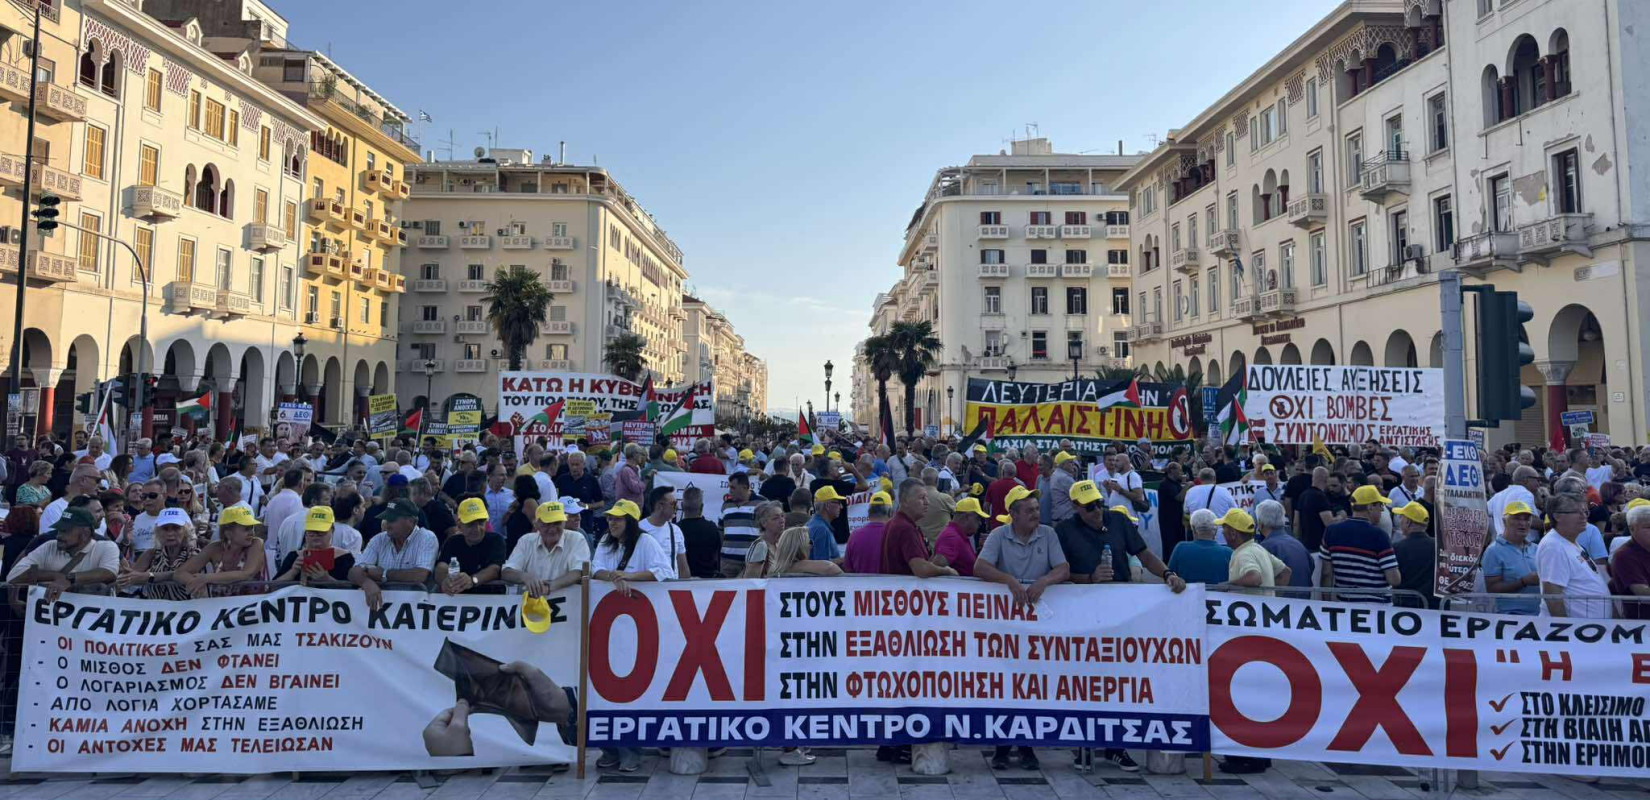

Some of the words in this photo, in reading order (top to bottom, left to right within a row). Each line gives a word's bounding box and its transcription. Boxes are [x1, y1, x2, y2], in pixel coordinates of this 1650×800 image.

[502, 377, 563, 392] ΚΑΤΩ
[568, 378, 584, 393] Η
[1249, 366, 1331, 391] ΔΟΥΛΕΙΕΣ
[1341, 368, 1423, 393] ΑΥΞΗΣΕΙΣ
[503, 396, 531, 406] ΤΟΥ
[611, 398, 638, 410] ΤΗΣ
[981, 381, 1098, 404] ΛΕΥΤΕΡΙΑ
[1327, 396, 1393, 421] ΒΟΜΒΕΣ
[978, 404, 1164, 440] ΠΑΛΑΙΣΤΙΝΗ
[1273, 422, 1376, 444] ΣΥΝΤΟΝΙΣΜΟΣ
[1379, 425, 1432, 436] ΕΡΓΑΤΙΚΗΣ
[1444, 463, 1479, 487] ΔΕΘ
[34, 598, 202, 636] ΕΡΓΑΤΙΚΟ
[211, 596, 352, 631] ΚΕΝΤΡΟ
[367, 596, 568, 632] ΚΑΤΕΡΙΝΣ
[780, 591, 846, 618] ΣΤΟΥΣ
[854, 589, 949, 617] ΜΙΣΘΟΥΣ
[957, 592, 1039, 622] ΠΕΙΝΑΣ
[1206, 600, 1422, 636] ΣΩΜΑΤΕΙΟ
[1440, 614, 1646, 644] ΕΡΓΑΖΟΜ
[57, 636, 72, 651] ΟΙ
[84, 640, 180, 657] ΠΟΛΙΤΙΚΕΣ
[194, 636, 232, 653] ΣΑΣ
[247, 633, 282, 647] ΜΑΣ
[295, 632, 394, 651] ΤΣΑΚΙΖΟΥΝ
[588, 588, 766, 704] ΟΧΙ
[780, 631, 838, 658] ΣΤΗΝ
[845, 630, 967, 657] ΕΞΑΘΛΙΩΣΗ
[974, 632, 1020, 659] ΤΩΝ
[1027, 635, 1202, 665] ΣΥΝΤΑΞΙΟΥΧΩΝ
[57, 656, 69, 670] Ο
[80, 659, 147, 675] ΜΙΣΘΟΣ
[161, 657, 202, 674] ΔΕΝ
[217, 654, 280, 670] ΦΤΑΝΕΙ
[56, 676, 69, 689] Ο
[80, 676, 208, 693] ΛΟΓΑΡΙΑΣΜΟΣ
[220, 675, 257, 689] ΔΕΝ
[269, 674, 340, 689] ΒΓΑΙΝΕΙ
[780, 672, 838, 699] ΣΤΗΝ
[845, 671, 1004, 699] ΦΤΩΧΟΠΟΙΗΣΗ
[1012, 673, 1048, 700] ΚΑΙ
[1055, 675, 1154, 704] ΑΝΕΡΓΙΑ
[50, 698, 92, 712] ΑΠΟ
[105, 698, 159, 712] ΛΟΓΙΑ
[171, 696, 278, 712] ΧΟΡΤΑΣΑΜΕ
[1208, 635, 1478, 759] ΟΧΙ
[1520, 691, 1555, 716] ΣΤΟ
[1558, 693, 1646, 717] ΚΛΕΙΣΙΜΟ
[49, 717, 109, 733] ΚΑΜΙΑ
[120, 717, 188, 732] ΑΝΟΧΗ
[200, 716, 246, 731] ΣΤΗΝ
[258, 716, 364, 731] ΕΞΑΘΛΙΩΣΗ
[588, 716, 771, 741] ΕΡΓΑΤΙΚΟ
[784, 713, 931, 740] ΚΕΝΤΡΟ
[945, 714, 1193, 745] Ν.ΚΑΡΔΙΤΣΑΣ
[1520, 717, 1559, 739] ΣΤΗ
[1563, 718, 1624, 742] ΒΙΑΙΗ
[47, 738, 65, 754] ΟΙ
[78, 737, 168, 754] ΑΝΤΟΧΕΣ
[180, 737, 217, 752] ΜΑΣ
[231, 736, 333, 753] ΤΕΛΕΙΩΣΑΝ
[1521, 740, 1571, 765] ΣΤΗΝ
[1576, 744, 1650, 769] ΕΡΗΜΟ
